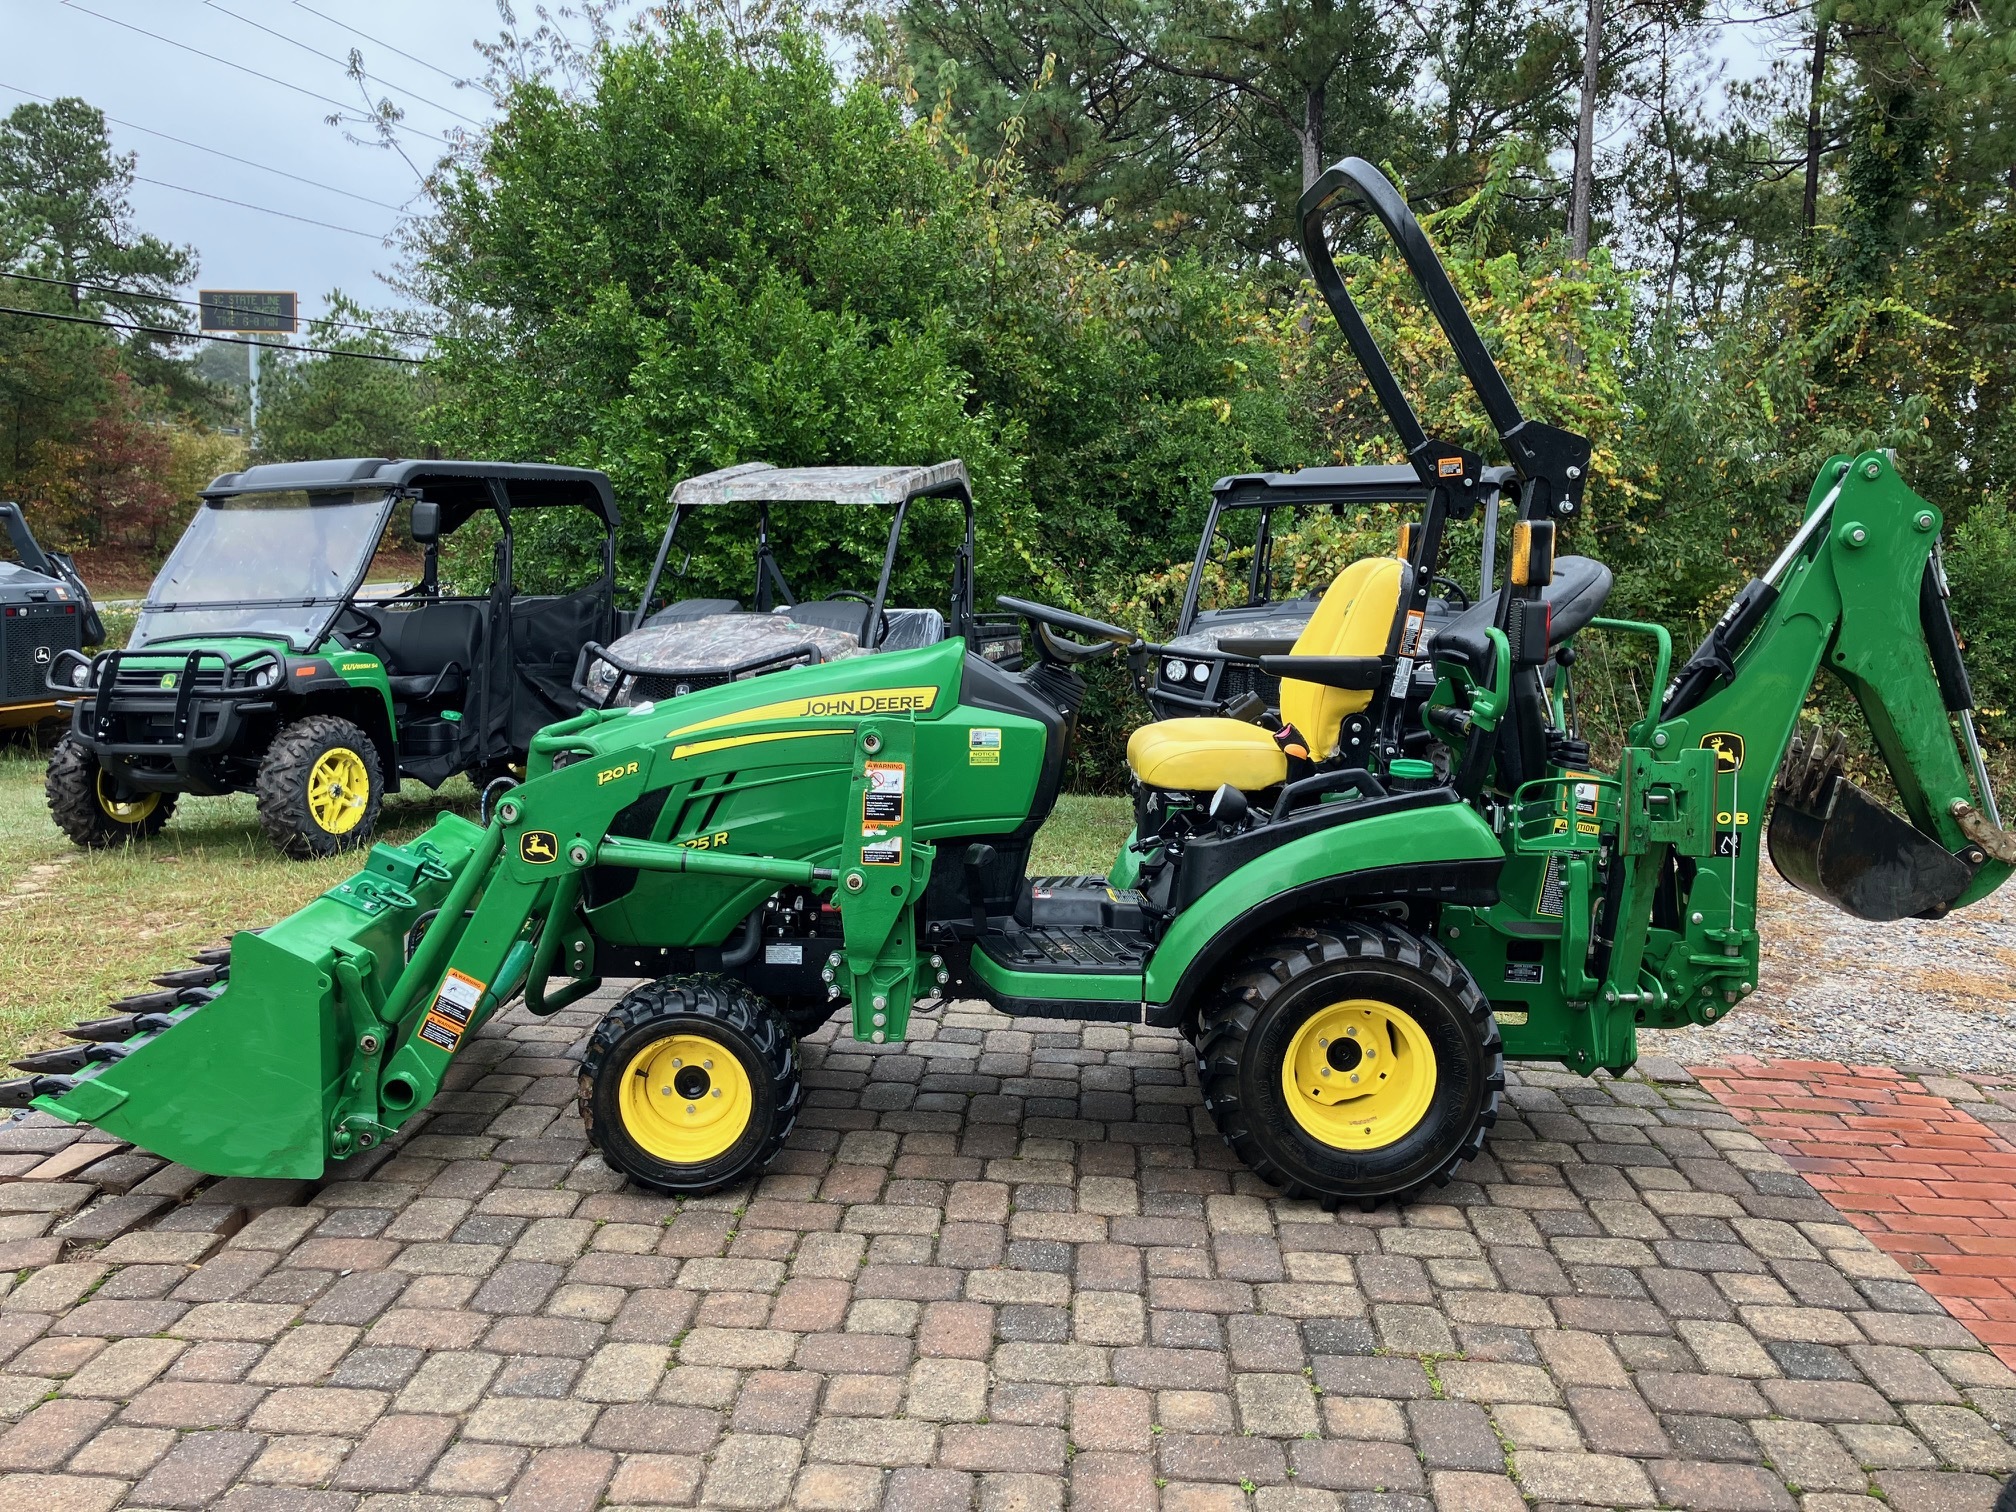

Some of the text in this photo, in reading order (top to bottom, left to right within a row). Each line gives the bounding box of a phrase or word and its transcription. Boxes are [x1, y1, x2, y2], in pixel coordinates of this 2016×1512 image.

[212, 295, 281, 306] SC STATE LINE
[263, 316, 279, 327] MIN
[800, 695, 925, 716] JOHN DEERE
[597, 761, 639, 786] 120 R
[713, 831, 728, 847] R
[458, 974, 481, 988] WARNING
